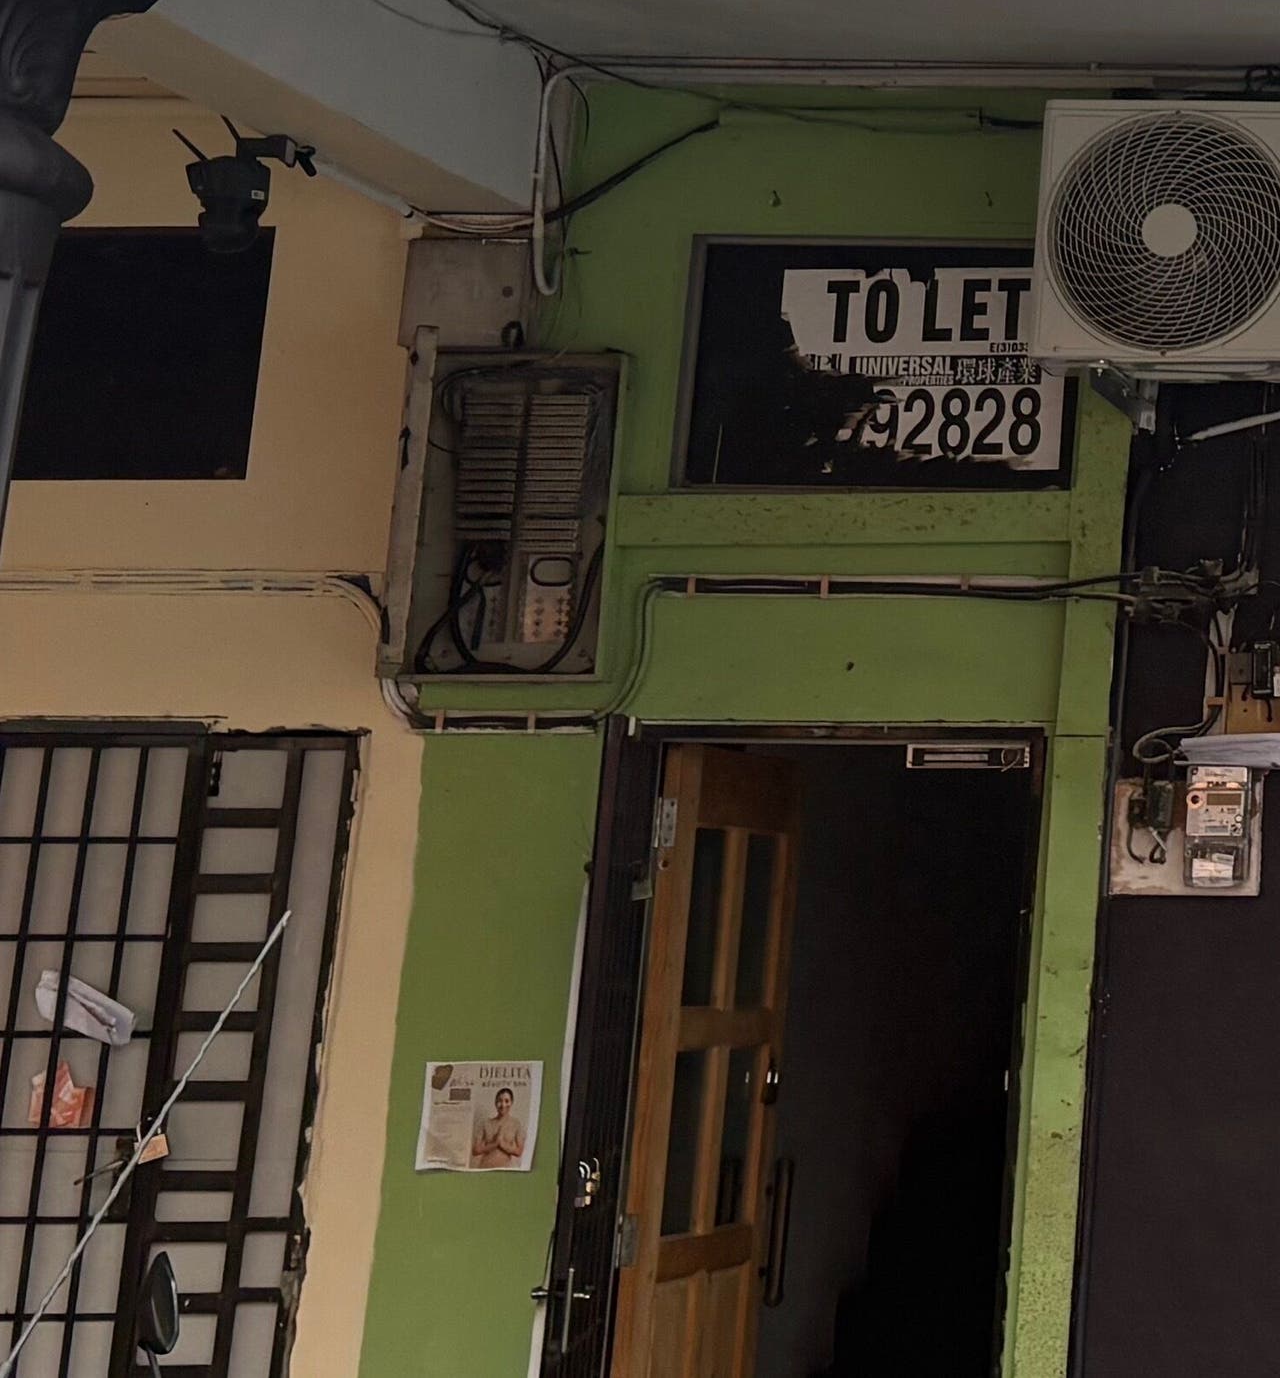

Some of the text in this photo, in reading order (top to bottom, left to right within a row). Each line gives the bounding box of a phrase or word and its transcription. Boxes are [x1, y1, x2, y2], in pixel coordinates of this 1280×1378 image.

[827, 277, 1032, 343] TO LET
[855, 357, 954, 378] UNIVERSAL
